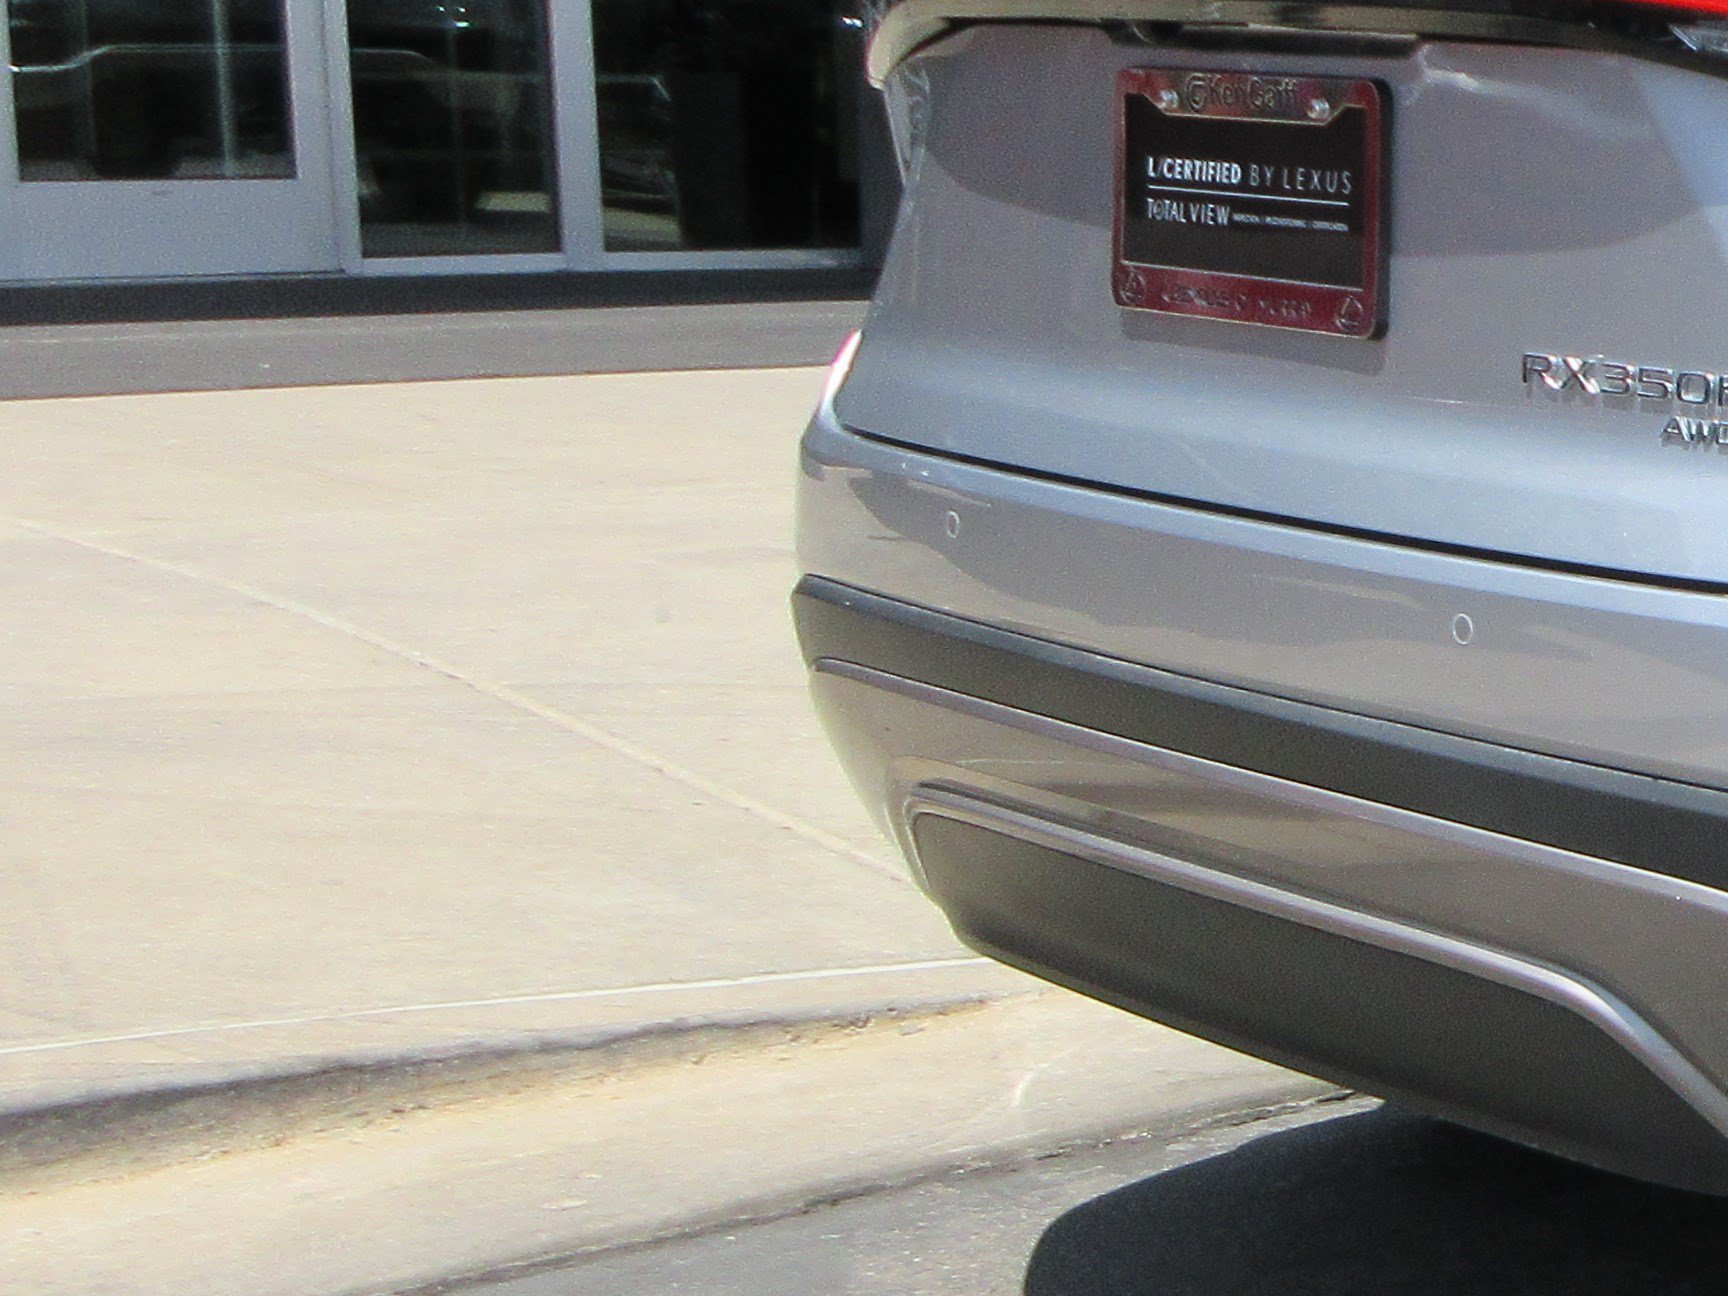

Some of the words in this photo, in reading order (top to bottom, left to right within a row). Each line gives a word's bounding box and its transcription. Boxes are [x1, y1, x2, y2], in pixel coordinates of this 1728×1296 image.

[1250, 164, 1274, 187] BY
[1282, 167, 1352, 195] LEXUS
[1189, 203, 1231, 226] VIEW
